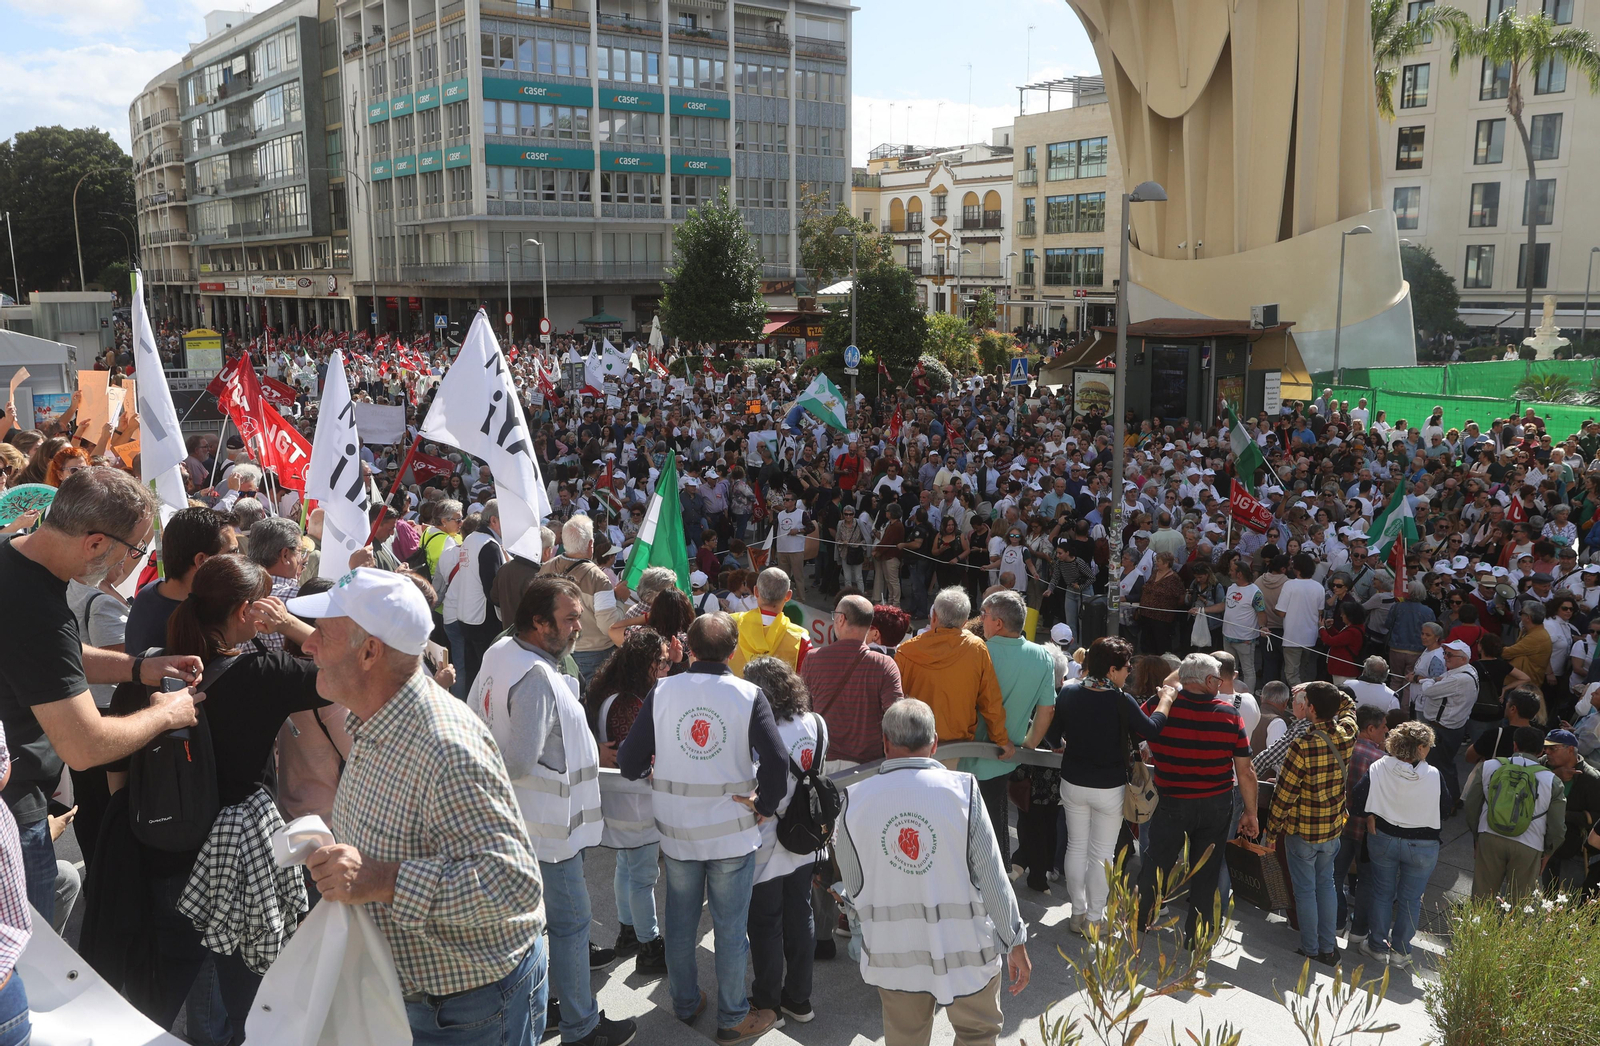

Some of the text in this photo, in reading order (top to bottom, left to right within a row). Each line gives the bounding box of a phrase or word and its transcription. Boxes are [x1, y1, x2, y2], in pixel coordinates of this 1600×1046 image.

[524, 86, 547, 96] caser
[618, 95, 638, 104] caser
[688, 102, 707, 110] caser
[526, 152, 549, 161] caser
[620, 157, 640, 166] caser
[688, 160, 708, 169] caser
[1232, 491, 1260, 514] UGT
[679, 708, 695, 722] BLANCA
[882, 815, 898, 834] BLANCA
[895, 819, 921, 827] SALVEMOS
[894, 855, 916, 868] NUESTRA
[1230, 867, 1260, 890] DORADO
